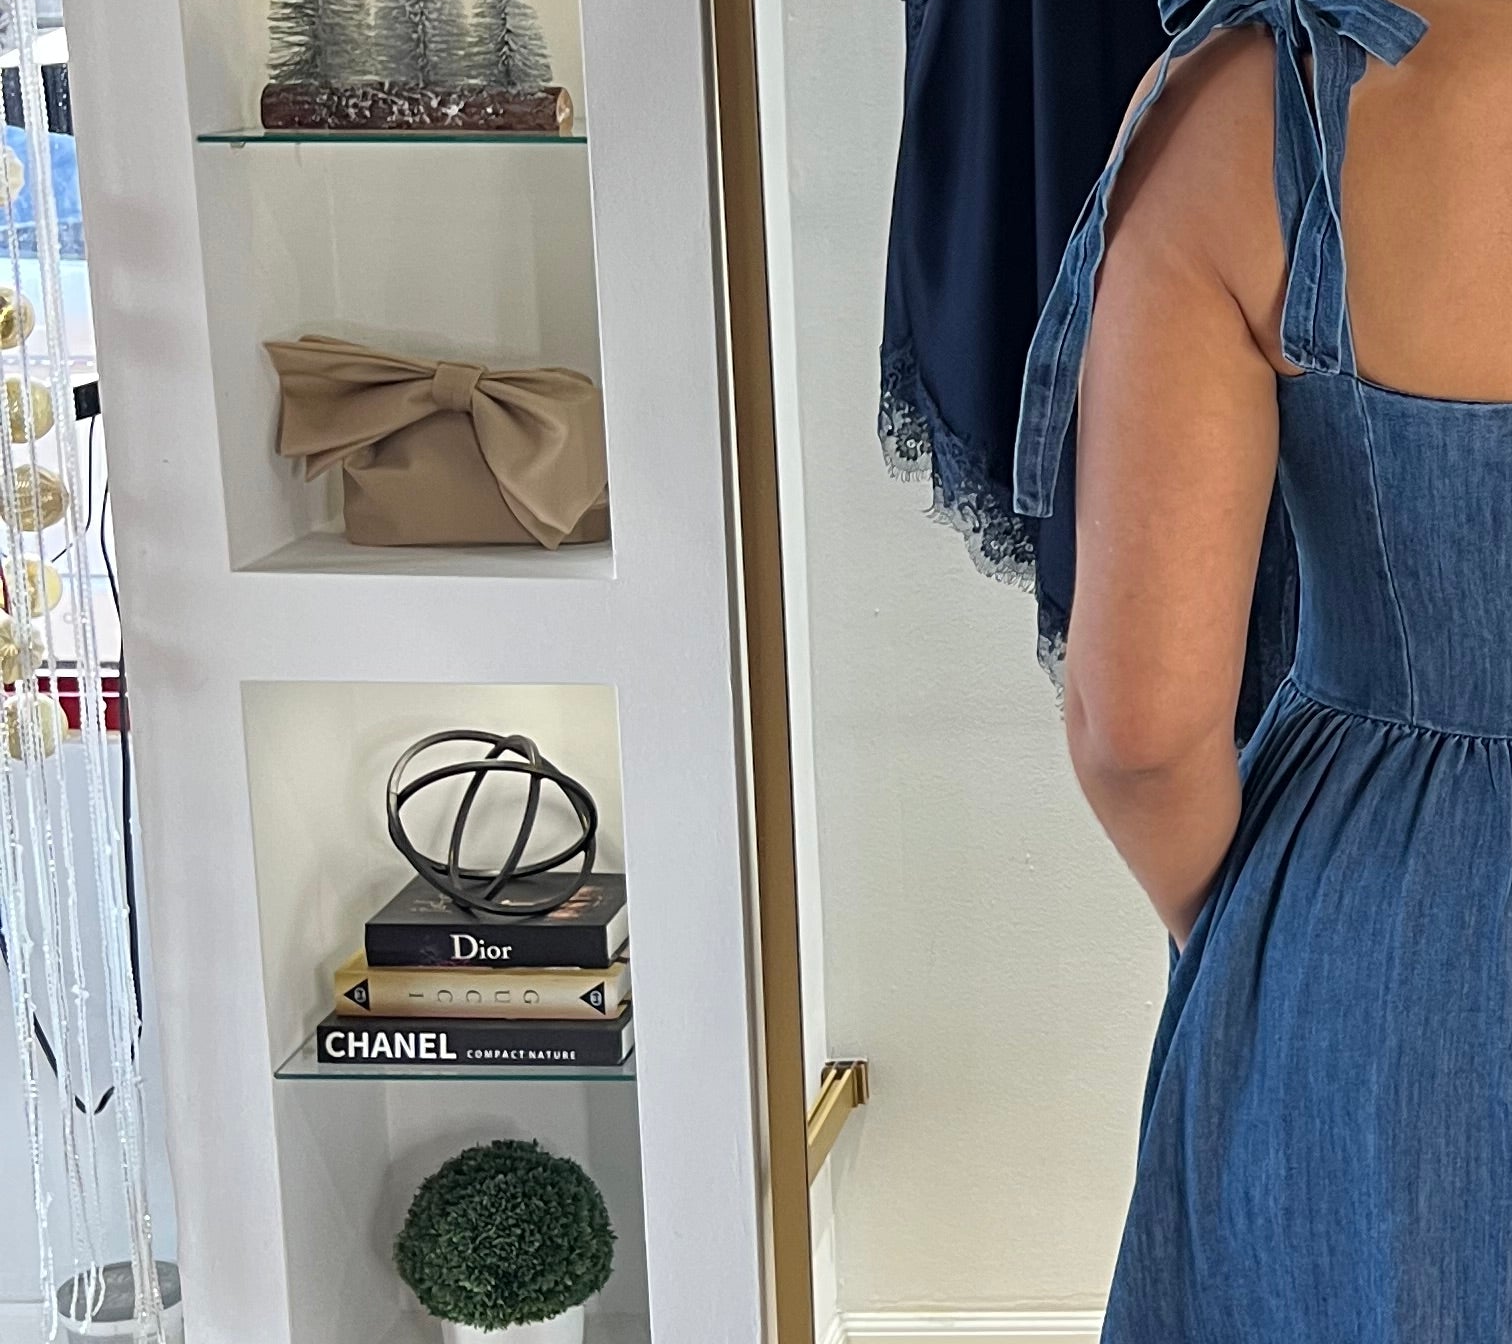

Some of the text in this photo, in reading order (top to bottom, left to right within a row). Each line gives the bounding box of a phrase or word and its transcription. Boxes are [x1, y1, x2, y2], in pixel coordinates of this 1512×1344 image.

[450, 933, 512, 960] Dior
[324, 1031, 576, 1061] CHANEL COMPACT NATURE
